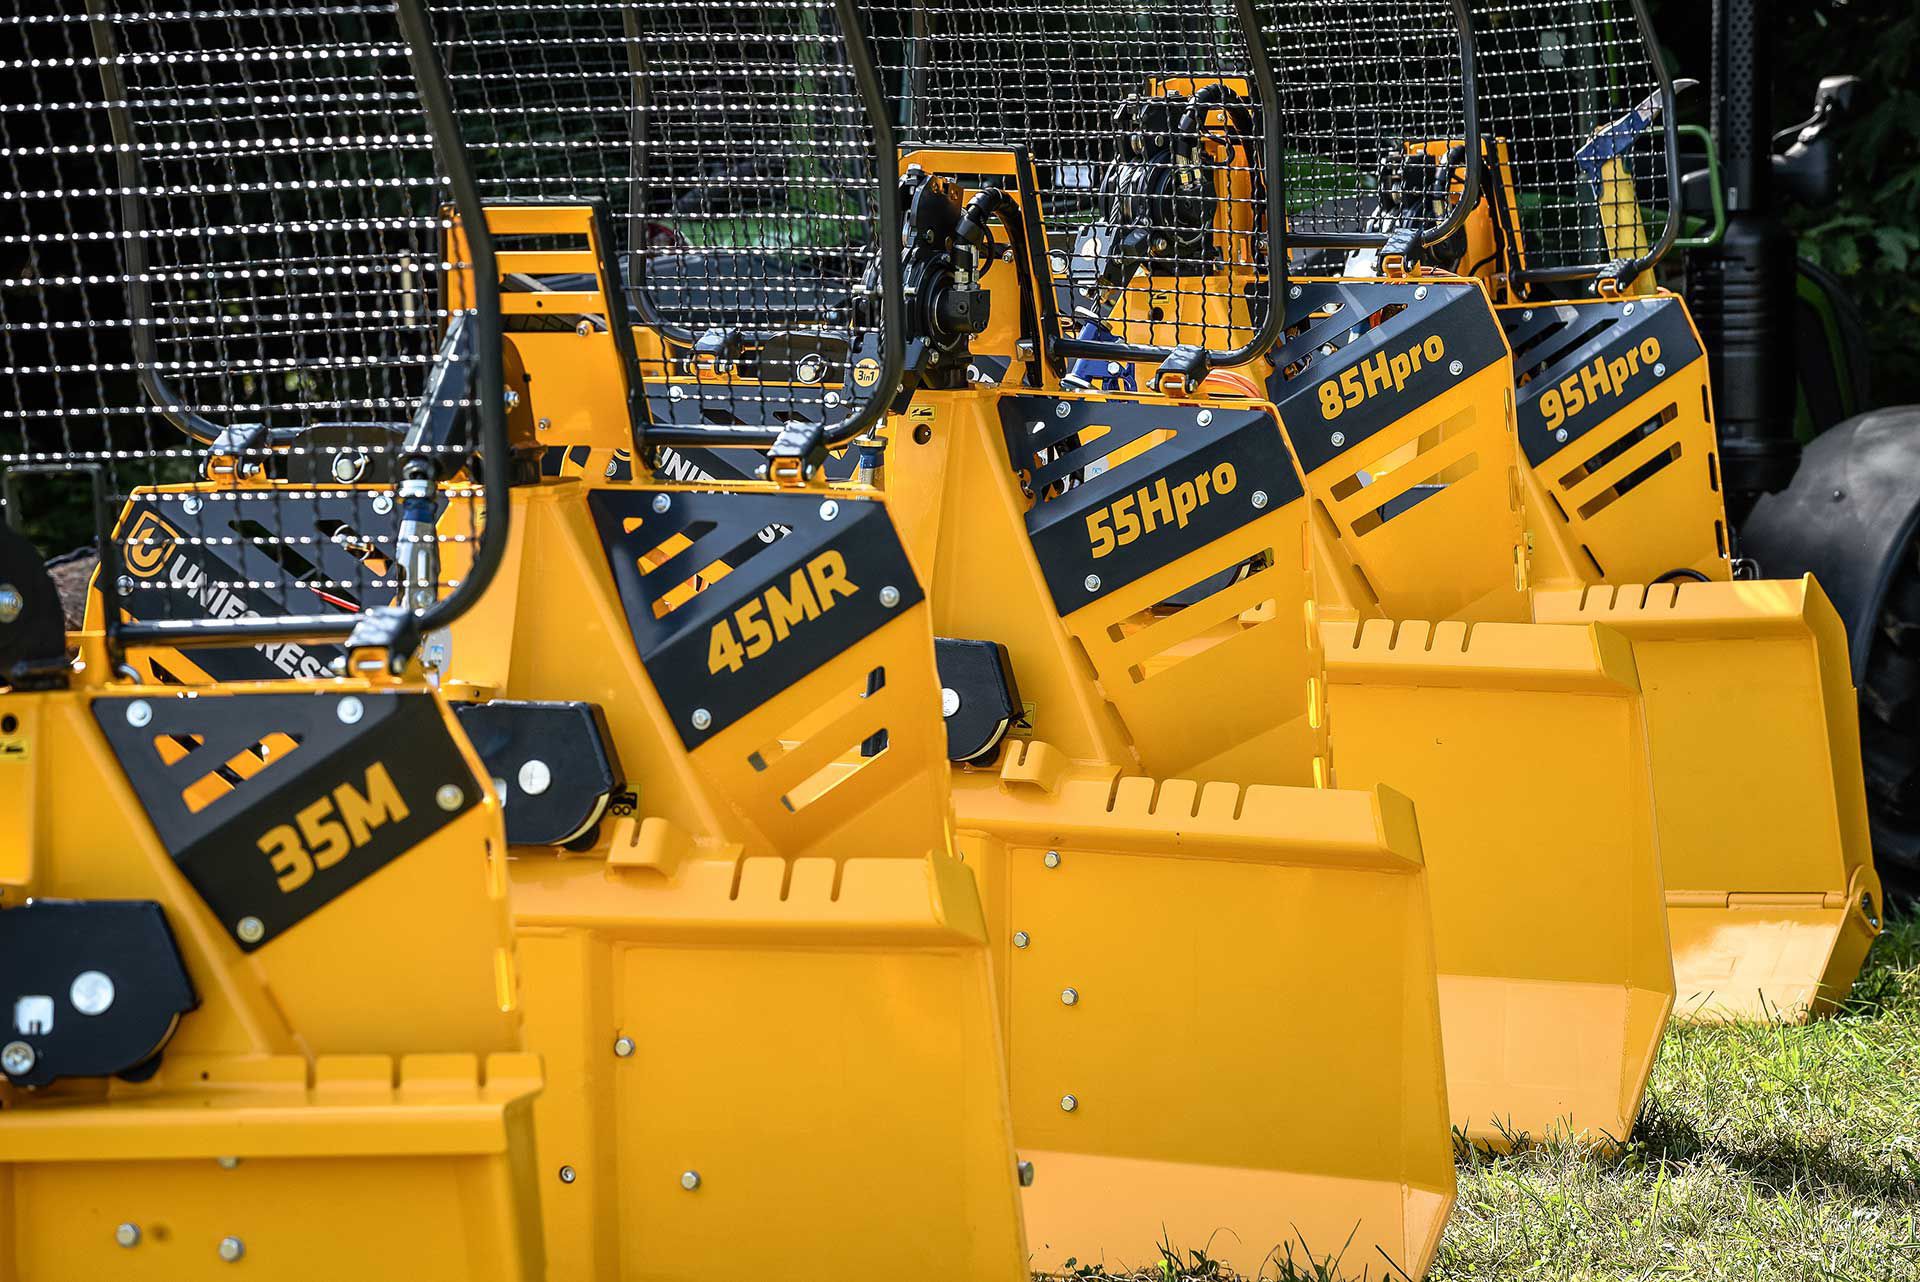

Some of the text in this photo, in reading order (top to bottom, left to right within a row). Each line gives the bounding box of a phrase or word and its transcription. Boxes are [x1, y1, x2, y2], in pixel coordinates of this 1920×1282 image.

[1318, 335, 1445, 420] 85Hpro
[1539, 337, 1661, 431] 95Hpro
[1085, 462, 1237, 559] 55Hpro
[708, 550, 860, 675] 45MR
[256, 761, 410, 893] 35M
